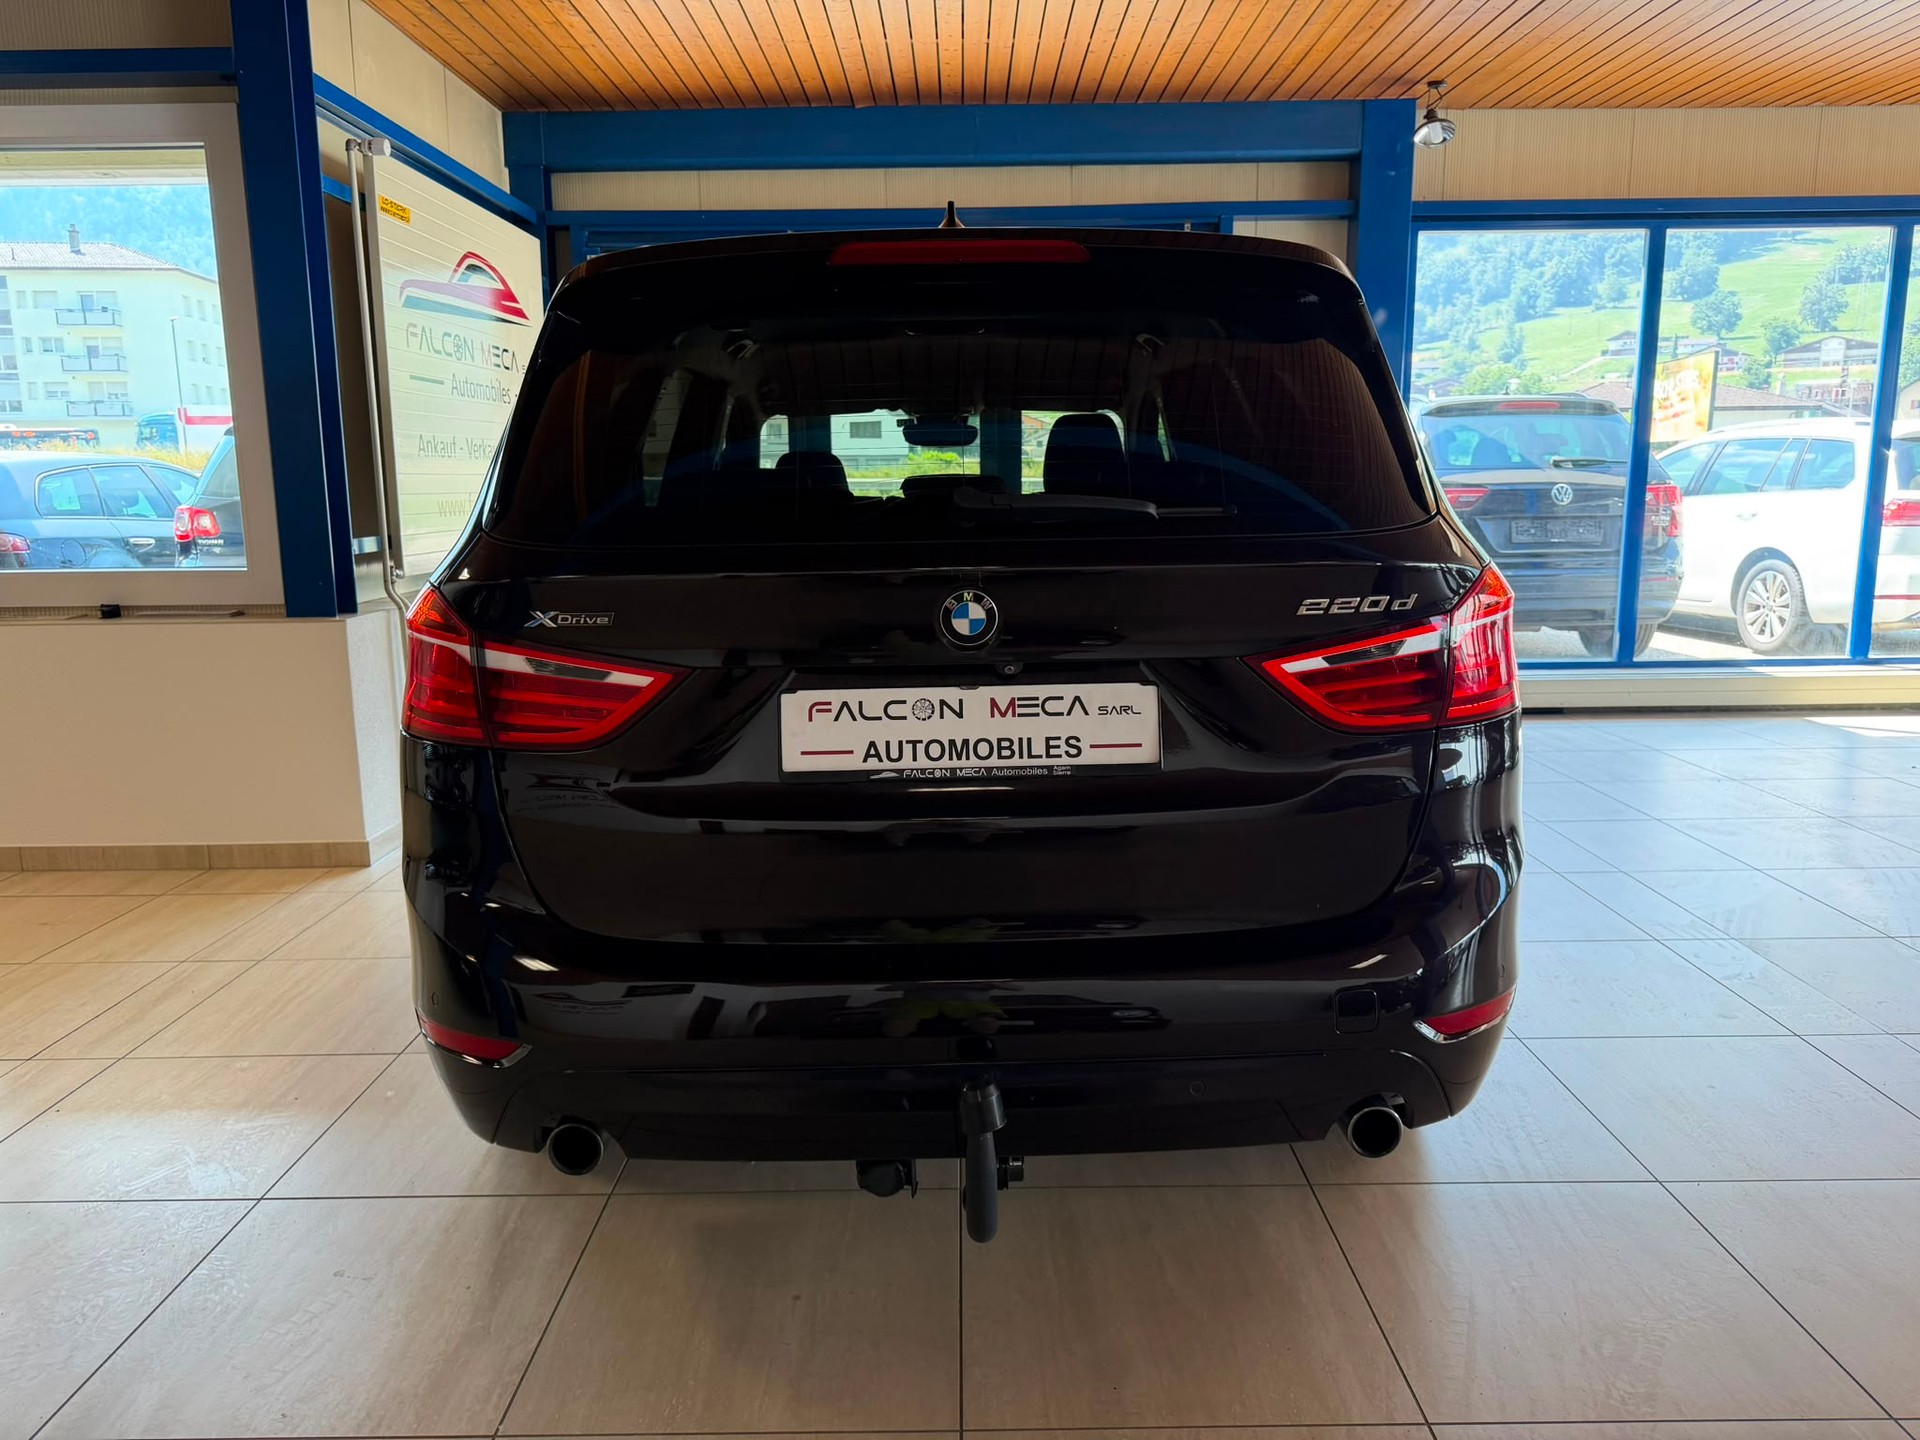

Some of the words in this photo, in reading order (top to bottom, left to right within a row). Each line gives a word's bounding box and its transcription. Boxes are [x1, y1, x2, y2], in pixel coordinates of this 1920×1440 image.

[405, 322, 475, 362] FALCON
[480, 341, 519, 374] MECA
[451, 372, 512, 405] Automobiles
[417, 433, 457, 459] Ankauf
[466, 437, 496, 460] Verka
[945, 592, 993, 611] BMW
[1296, 593, 1418, 616] 220d
[807, 697, 964, 723] FALCON
[989, 694, 1090, 720] MECA
[1097, 704, 1143, 717] SARL
[861, 735, 1083, 764] AUTOMOBILES
[903, 769, 950, 779] FALCON
[956, 768, 987, 777] MECA
[991, 766, 1049, 777] Automobiles
